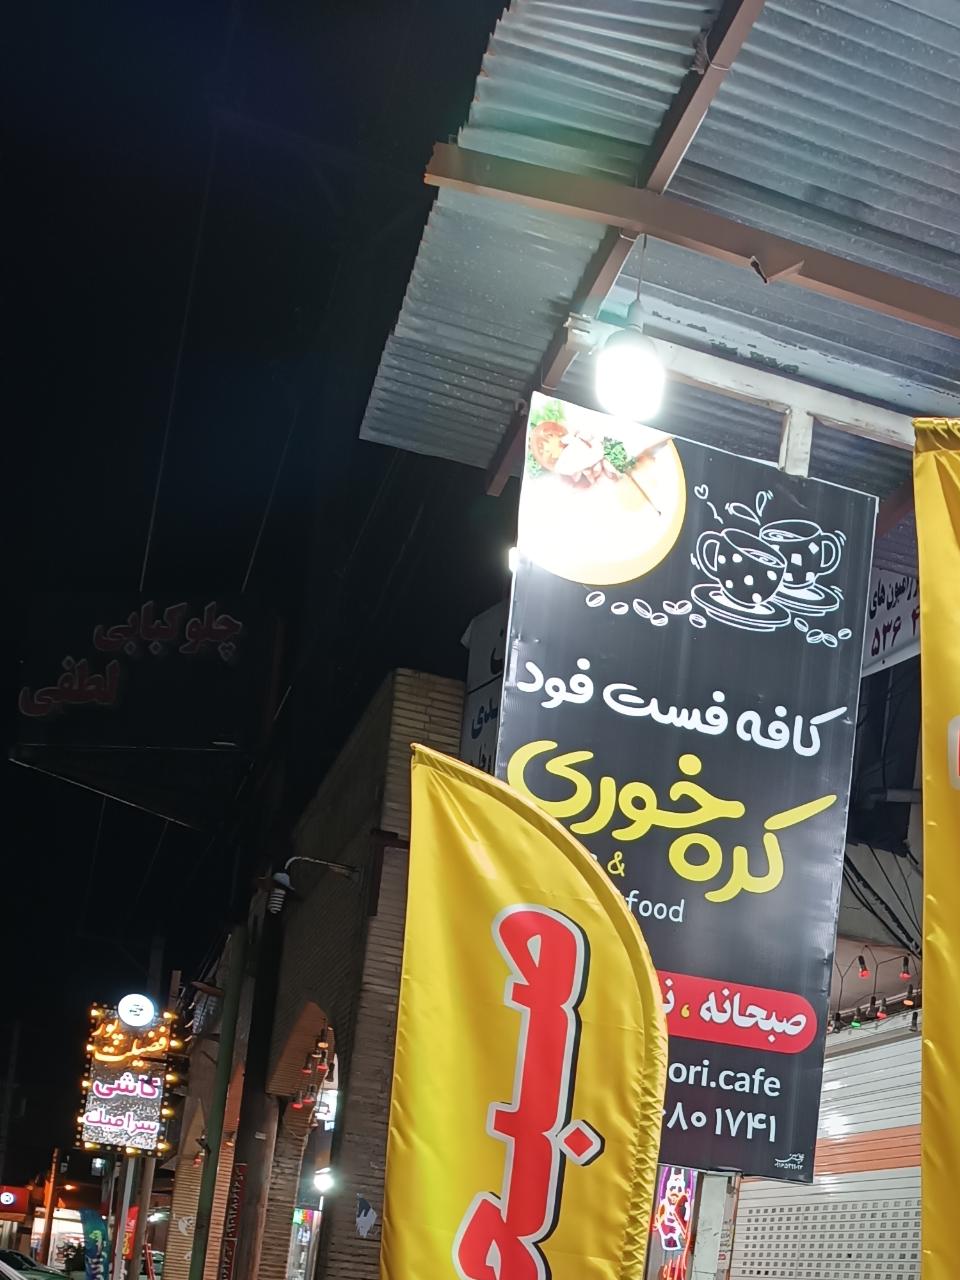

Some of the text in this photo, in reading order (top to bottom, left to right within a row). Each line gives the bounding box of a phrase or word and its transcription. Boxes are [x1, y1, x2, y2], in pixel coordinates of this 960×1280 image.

[517, 658, 594, 708] فود
[603, 683, 728, 735] فست
[736, 706, 847, 756] کافه
[507, 740, 837, 902] کره خوری
[700, 988, 806, 1043] صبحانه
[93, 1072, 160, 1098] کاشی
[668, 1060, 781, 1097] ori.cafe
[82, 1107, 160, 1136] سرامیک
